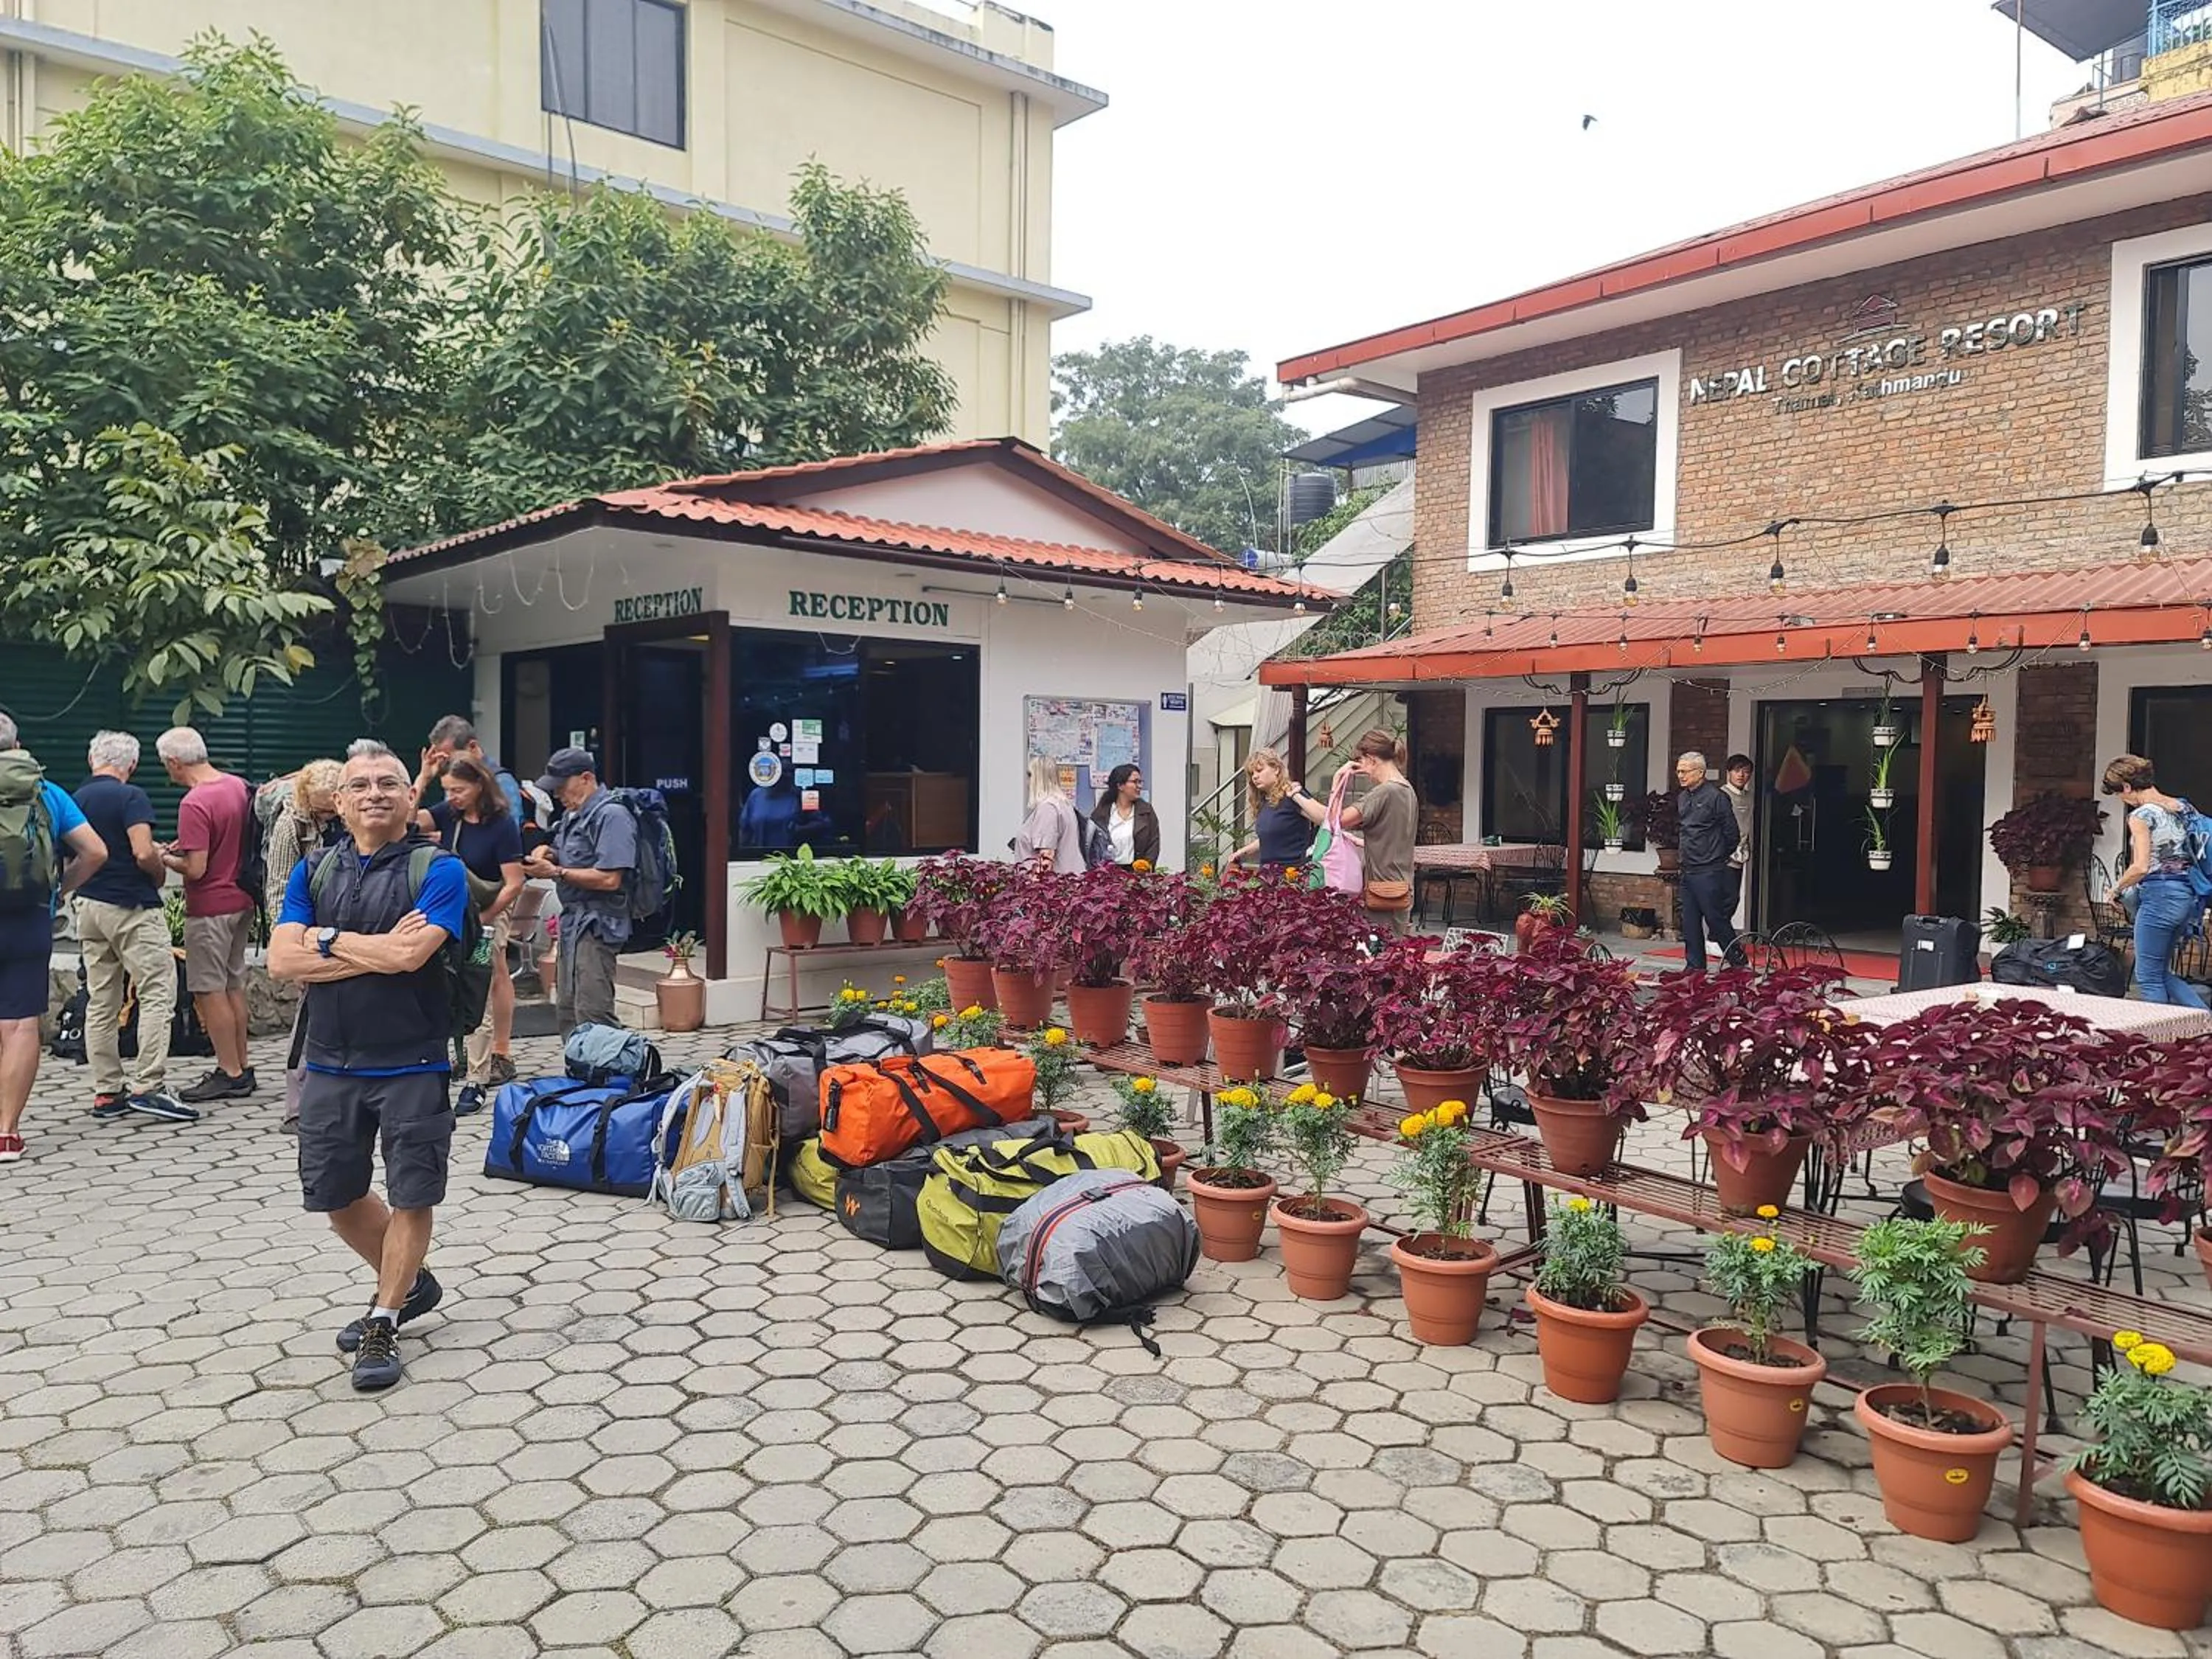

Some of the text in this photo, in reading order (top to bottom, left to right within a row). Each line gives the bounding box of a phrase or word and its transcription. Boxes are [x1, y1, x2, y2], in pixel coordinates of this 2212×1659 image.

[1689, 300, 2086, 405] NEPAL COTTAGE RESORT
[614, 587, 703, 622] RECEPTION
[788, 591, 950, 626] RECEPTION
[656, 778, 688, 789] PUSH
